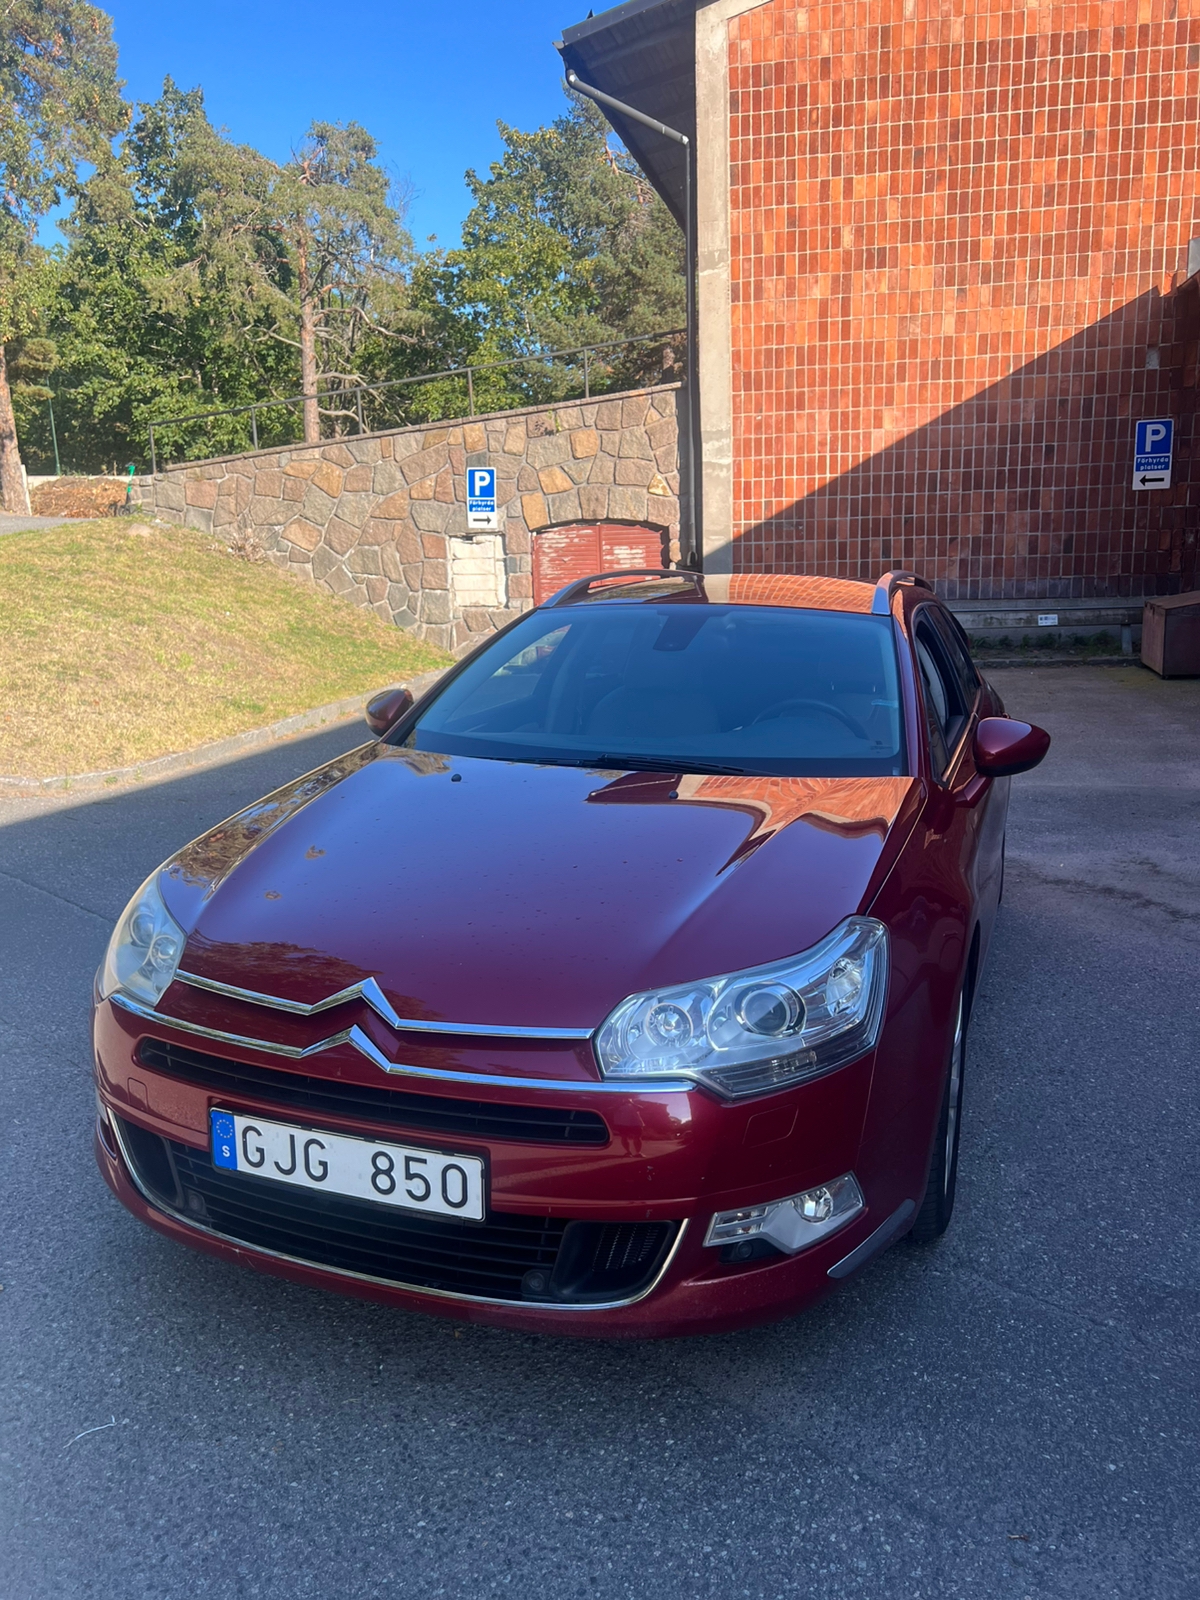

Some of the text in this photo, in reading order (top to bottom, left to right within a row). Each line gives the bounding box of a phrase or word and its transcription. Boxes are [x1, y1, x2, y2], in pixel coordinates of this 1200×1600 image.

[1145, 424, 1166, 452] P
[474, 471, 491, 496] P
[222, 1145, 230, 1158] S
[241, 1125, 468, 1209] GJG 850
